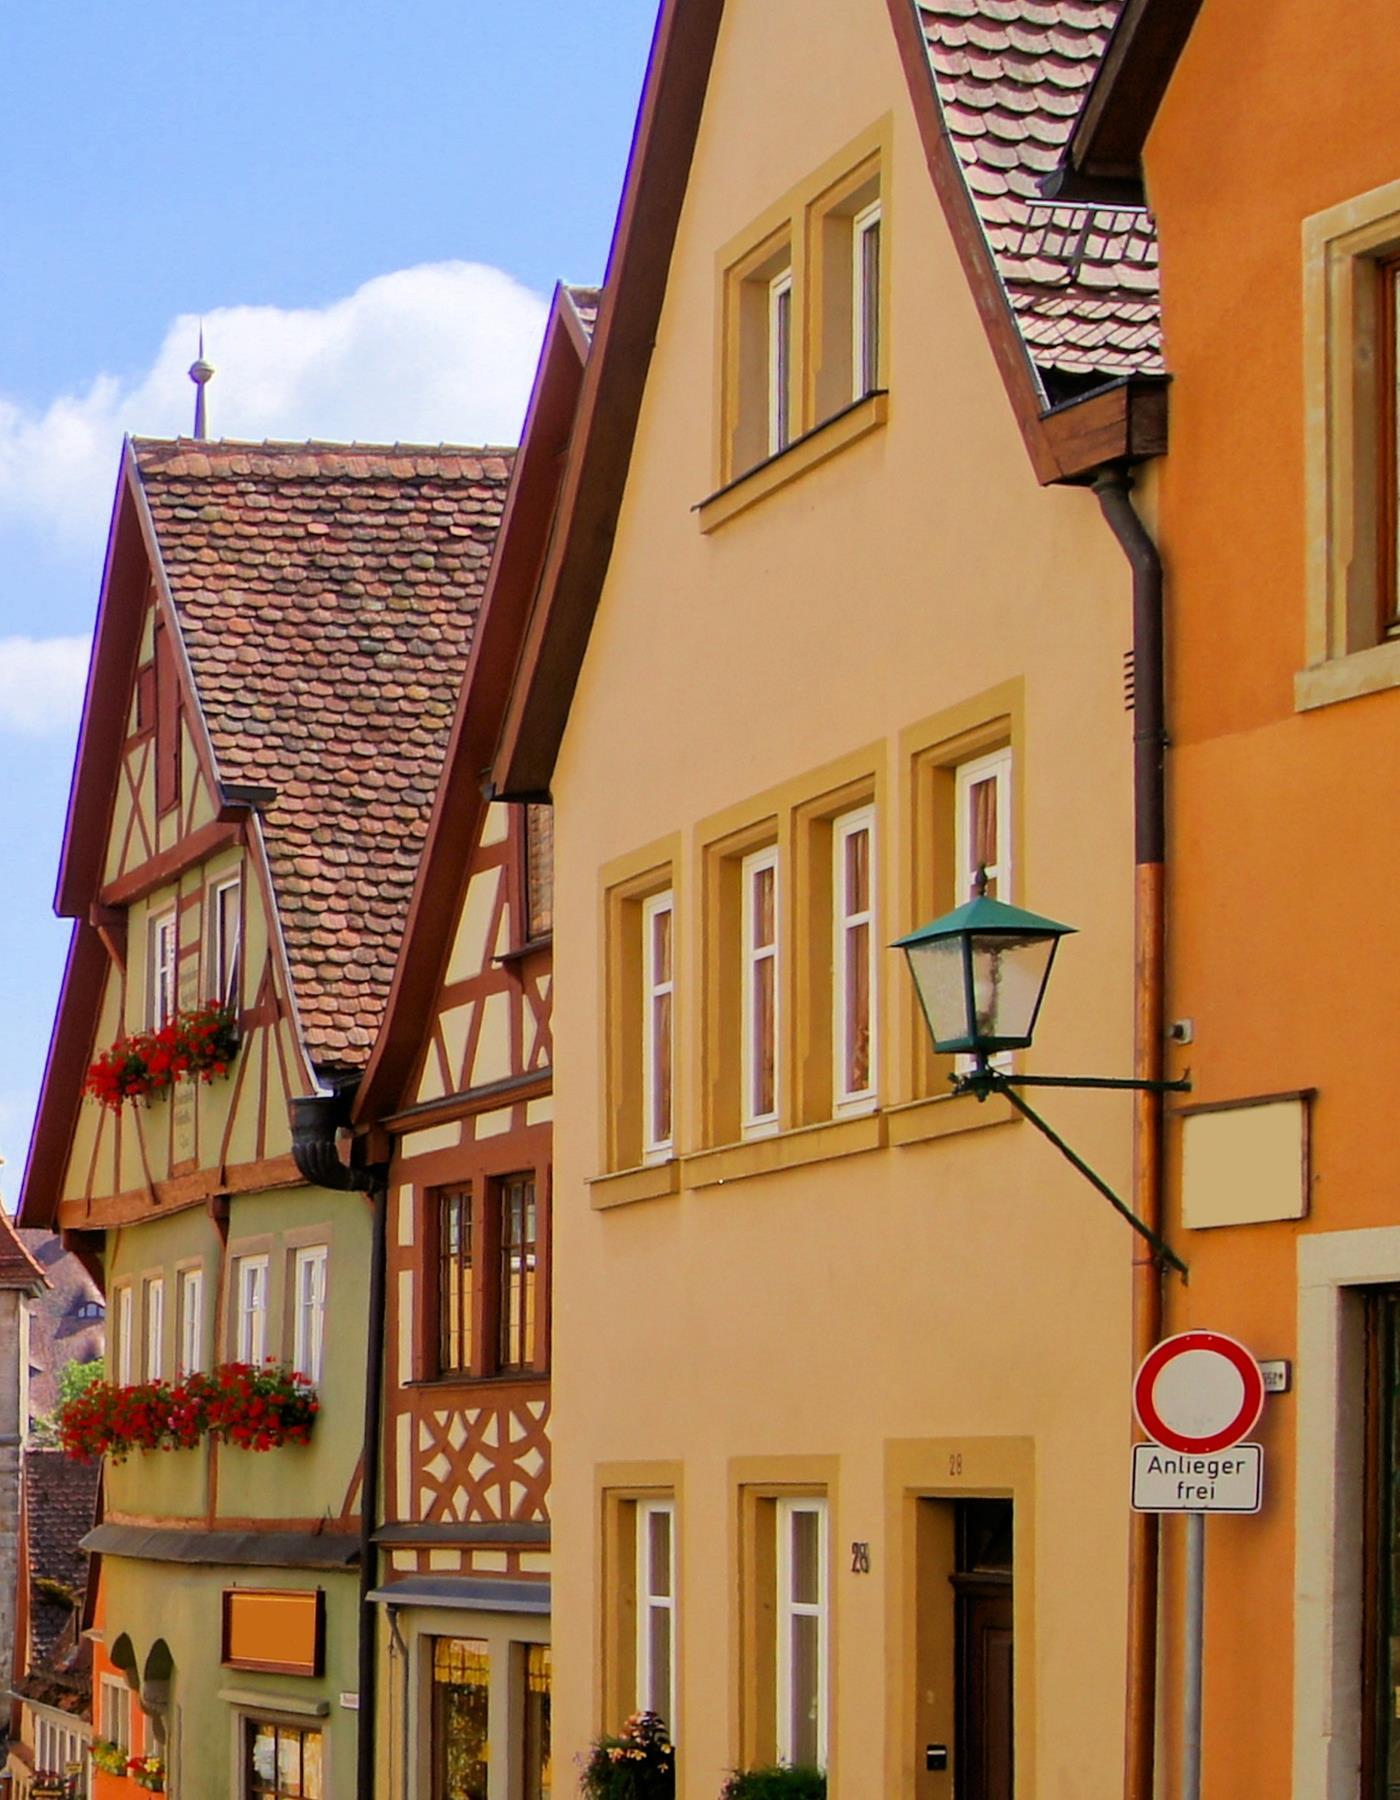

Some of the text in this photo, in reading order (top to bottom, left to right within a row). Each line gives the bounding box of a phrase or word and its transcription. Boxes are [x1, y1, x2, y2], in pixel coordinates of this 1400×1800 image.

[948, 1453, 963, 1476] 28
[1147, 1455, 1246, 1479] Anlieger
[1177, 1481, 1215, 1500] frei
[851, 1542, 870, 1574] 28
